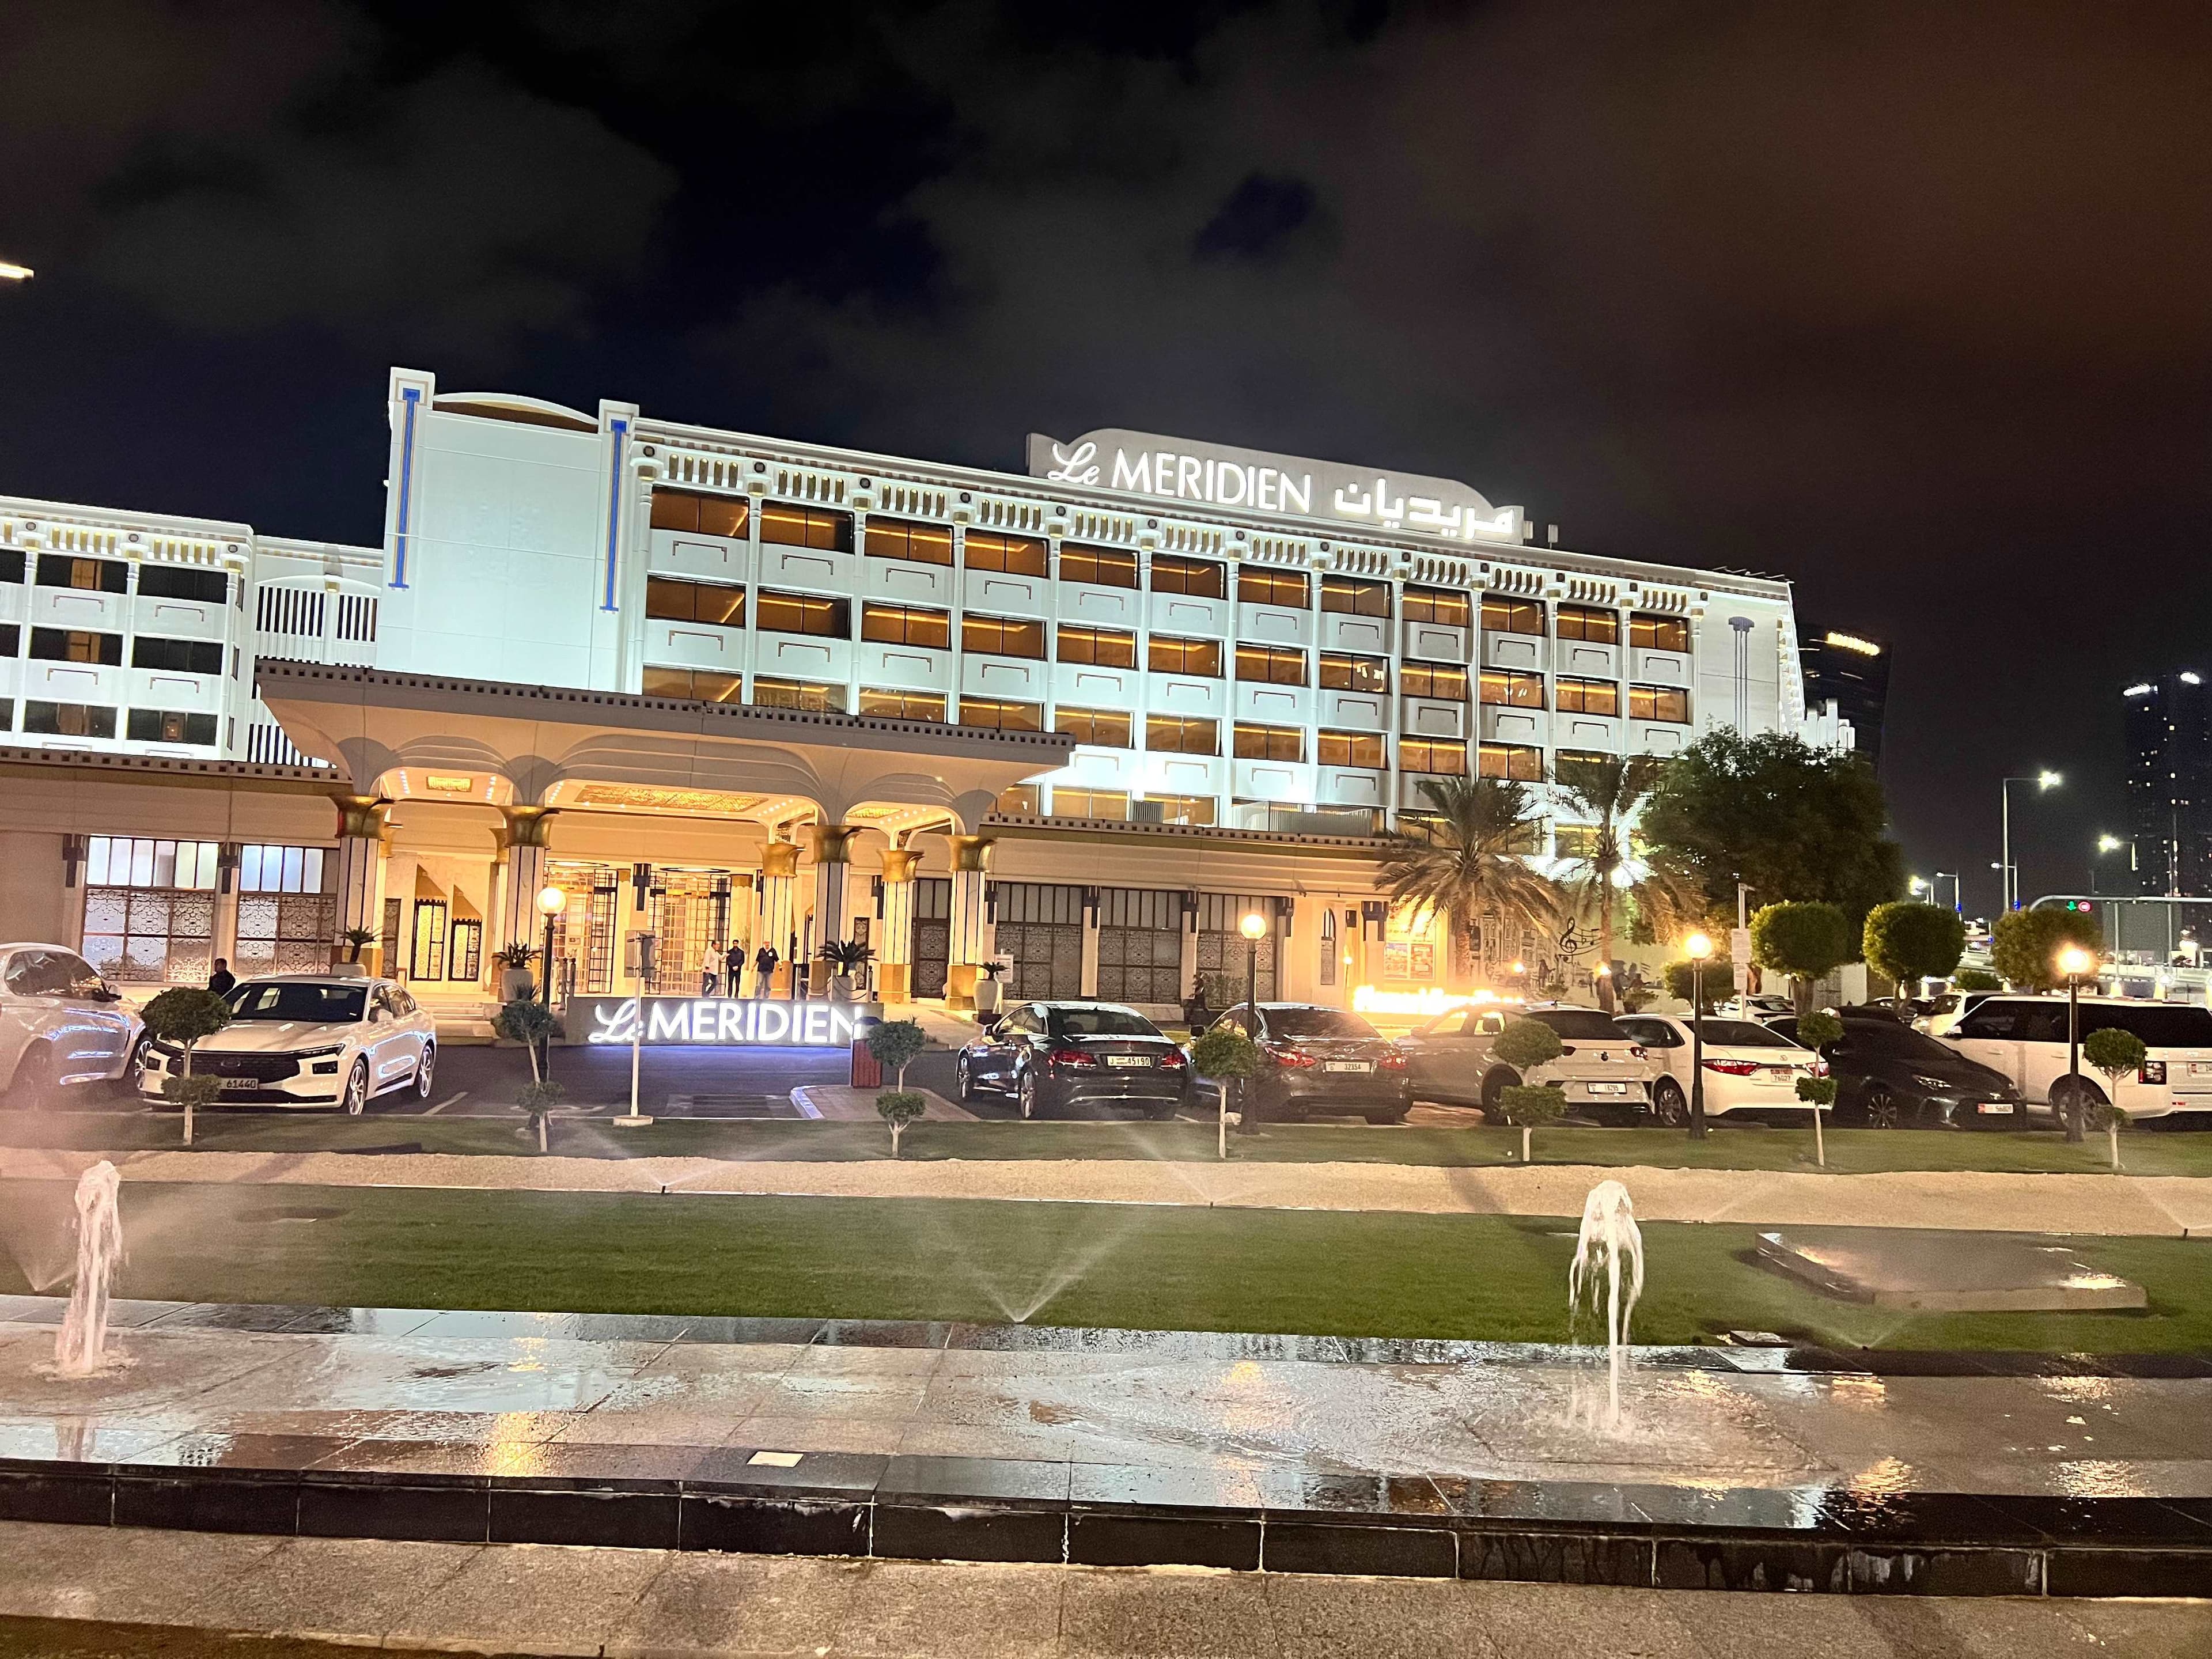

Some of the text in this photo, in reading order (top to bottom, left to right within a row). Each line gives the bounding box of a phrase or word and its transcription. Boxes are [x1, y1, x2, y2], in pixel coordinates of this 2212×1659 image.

[1047, 442, 1310, 514] Le MERIDIEN
[1334, 478, 1514, 540] مريديان
[647, 1001, 862, 1043] MERIDIEN
[226, 1080, 256, 1088] 61440
